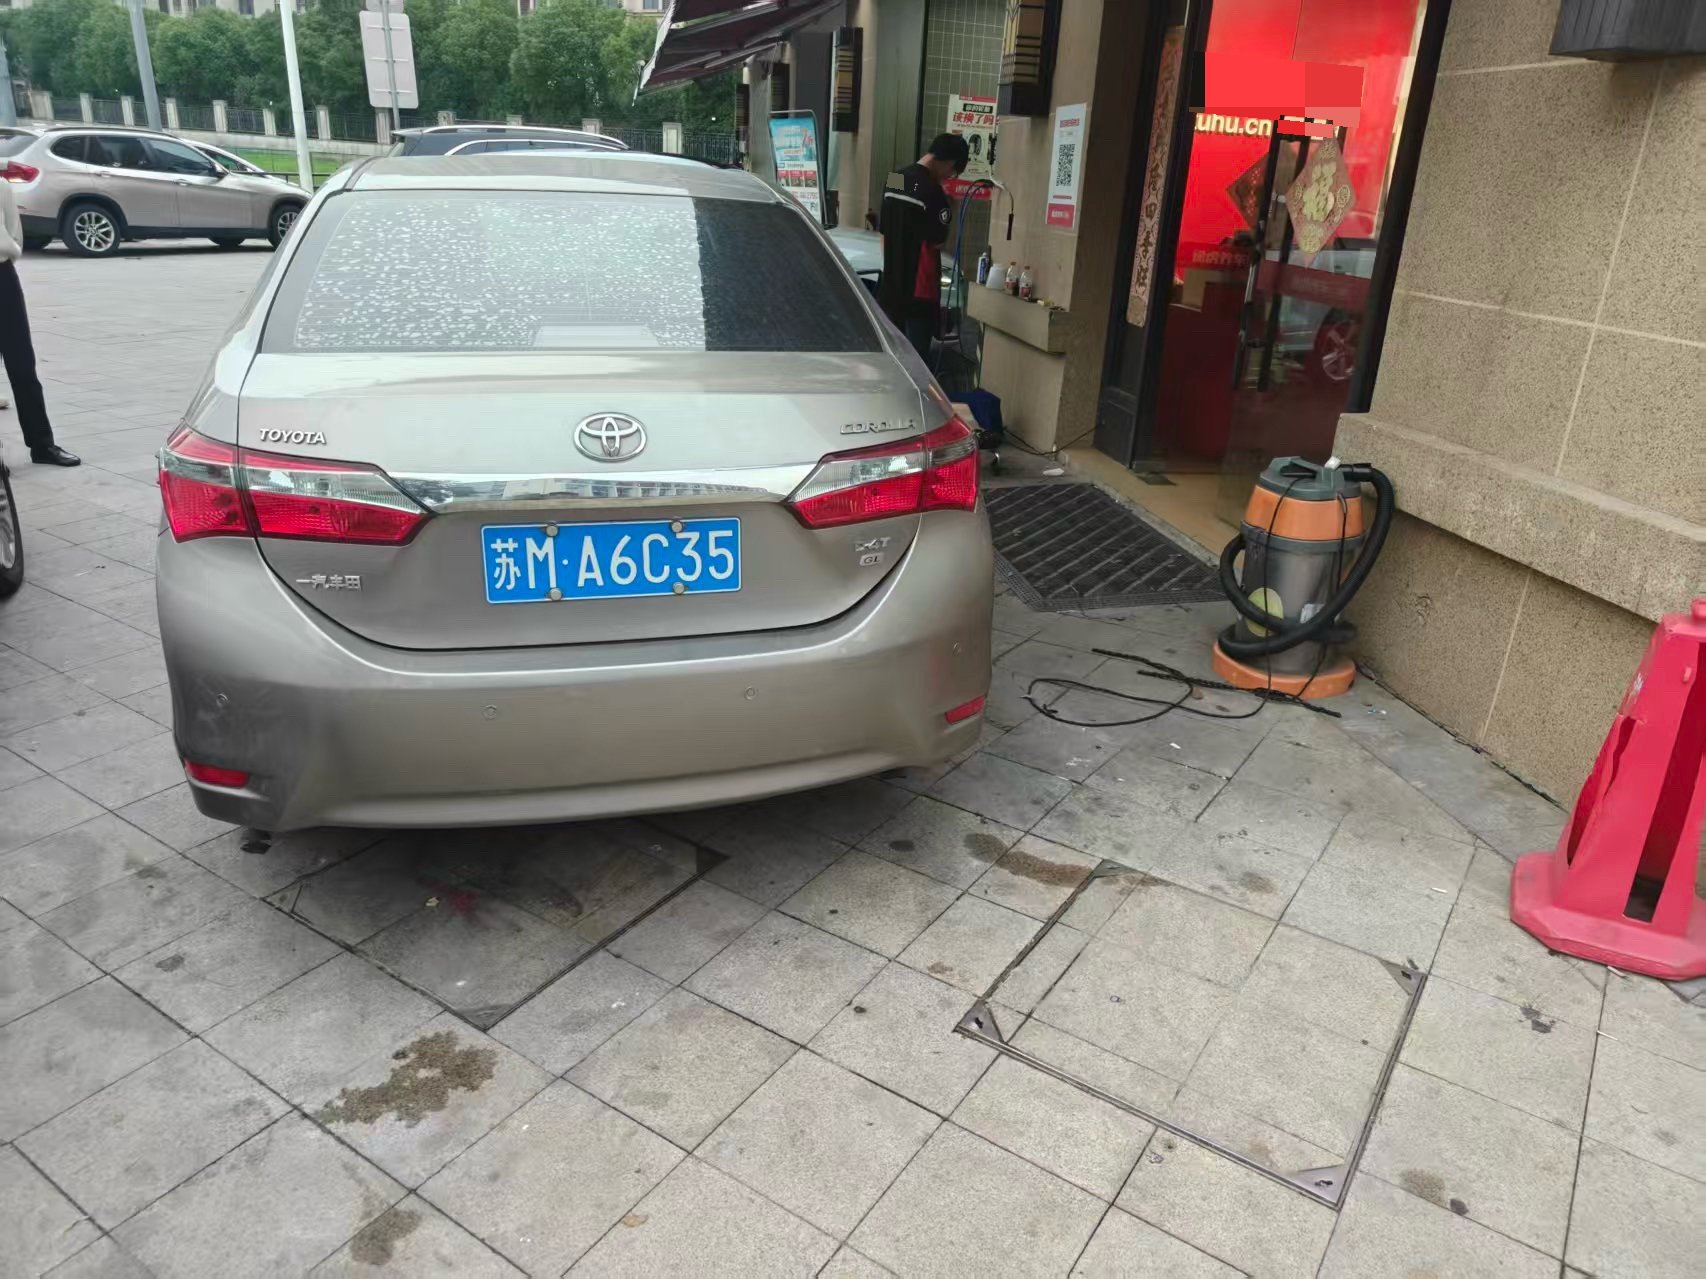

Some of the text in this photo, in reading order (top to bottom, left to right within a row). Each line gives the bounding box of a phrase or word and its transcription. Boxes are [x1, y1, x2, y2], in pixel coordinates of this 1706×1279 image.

[260, 428, 326, 445] TOYOTA
[295, 573, 361, 591] 一汽丰田
